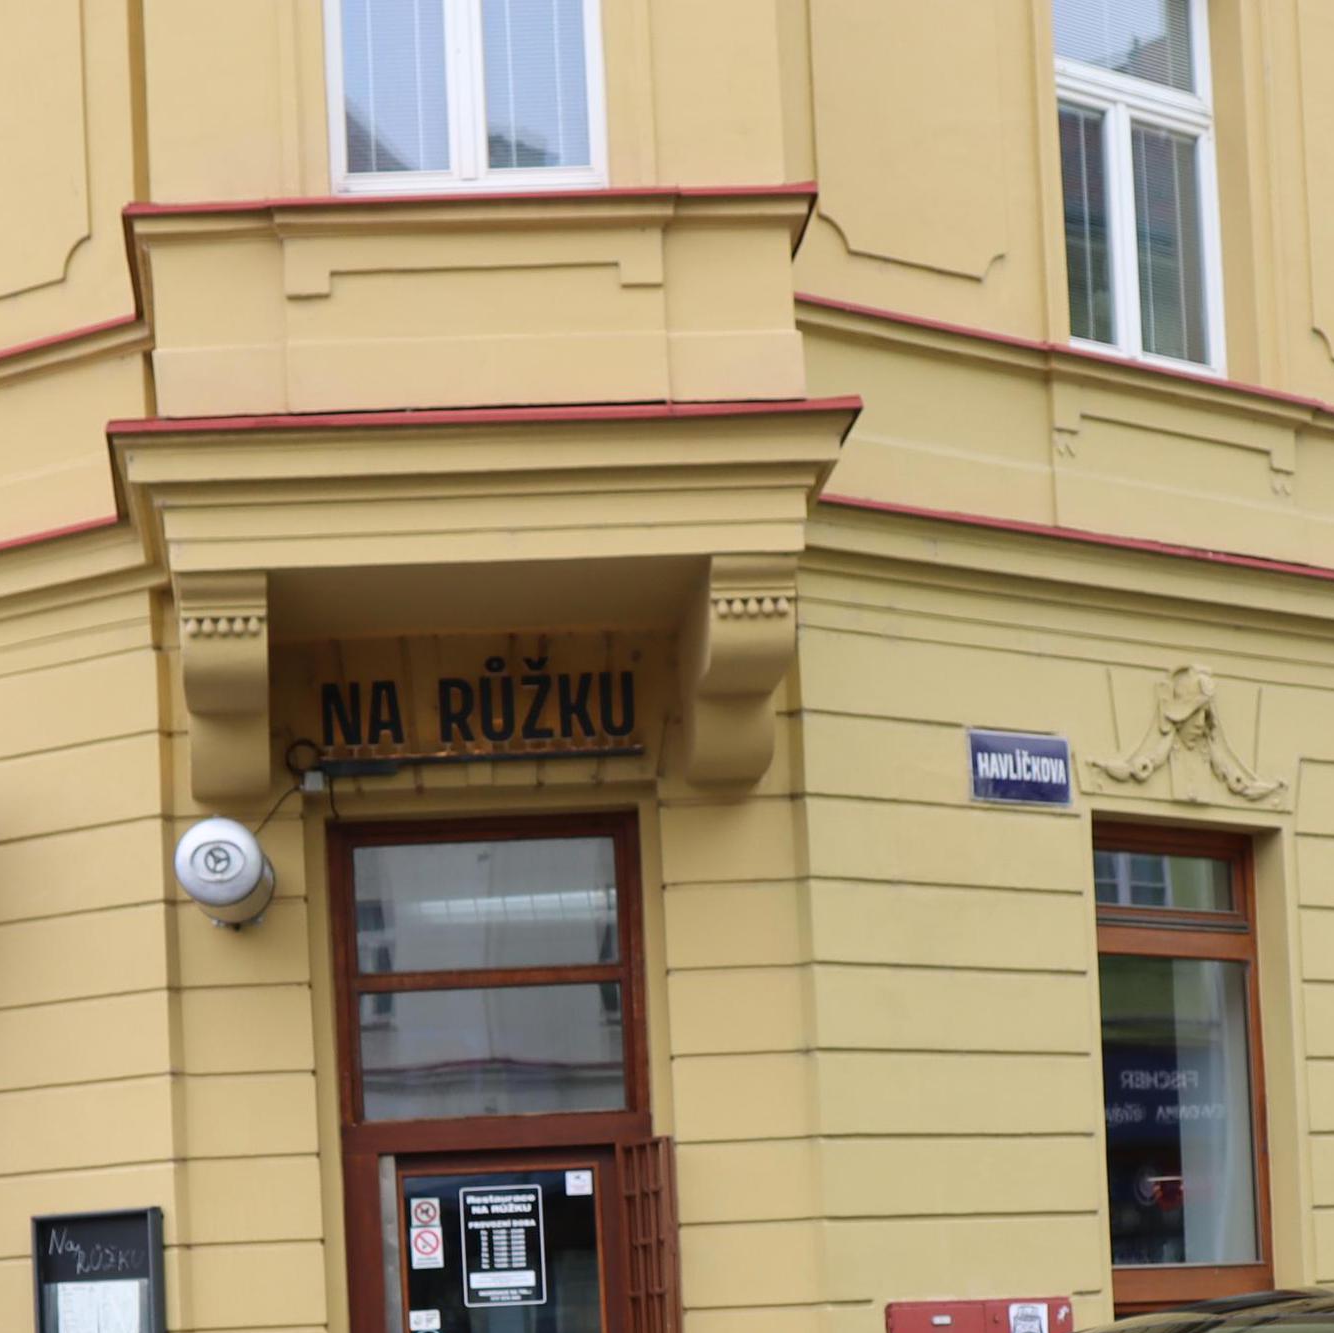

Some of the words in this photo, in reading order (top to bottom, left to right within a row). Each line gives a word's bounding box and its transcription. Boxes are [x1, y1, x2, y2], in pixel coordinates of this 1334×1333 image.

[321, 681, 405, 746] NA
[438, 656, 635, 743] RŮŽKU
[976, 748, 1067, 784] HAVLÍČKOVA
[471, 1205, 489, 1214] NA
